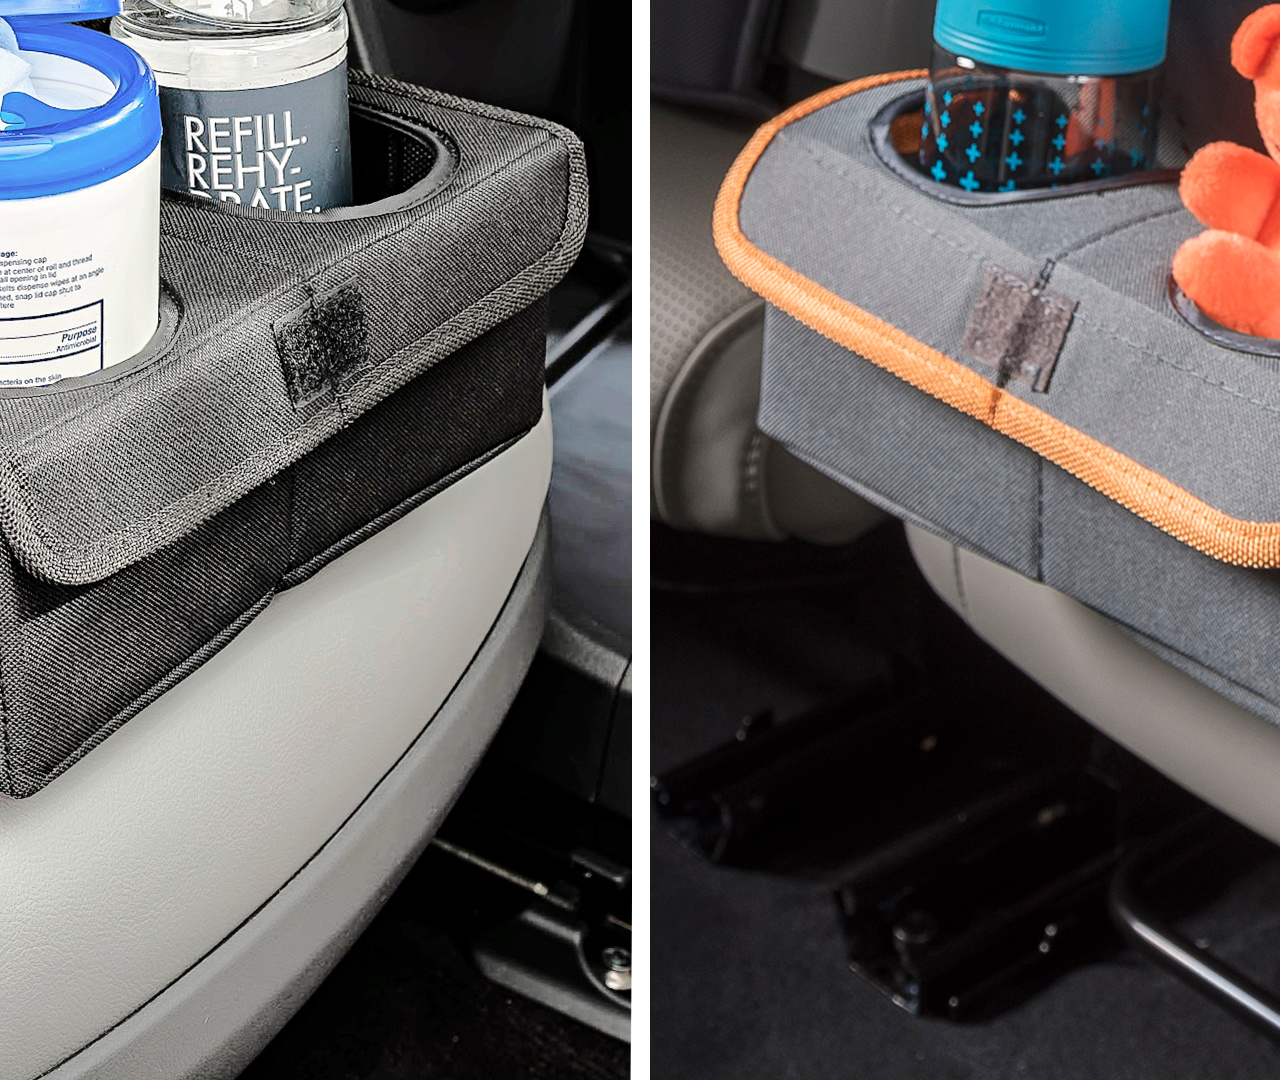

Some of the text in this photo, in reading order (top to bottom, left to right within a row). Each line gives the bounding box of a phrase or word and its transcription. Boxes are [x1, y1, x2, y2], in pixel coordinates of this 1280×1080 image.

[184, 110, 308, 153] REFILL.
[187, 148, 302, 190] REHY-
[189, 180, 321, 213] ATE.
[12, 267, 35, 275] center
[37, 265, 45, 273] of
[58, 260, 71, 269] and
[72, 253, 93, 266] thread
[33, 256, 47, 264] cap
[9, 274, 38, 283] opening
[17, 281, 49, 291] dispense
[50, 277, 70, 287] wipes
[71, 275, 78, 283] at
[88, 267, 104, 277] angle
[15, 292, 33, 300] snap
[44, 289, 57, 297] cap
[59, 285, 73, 295] shut
[61, 326, 97, 342] Purpose
[56, 335, 97, 352] Antimicrobial
[35, 375, 46, 383] the
[48, 373, 62, 382] skin
